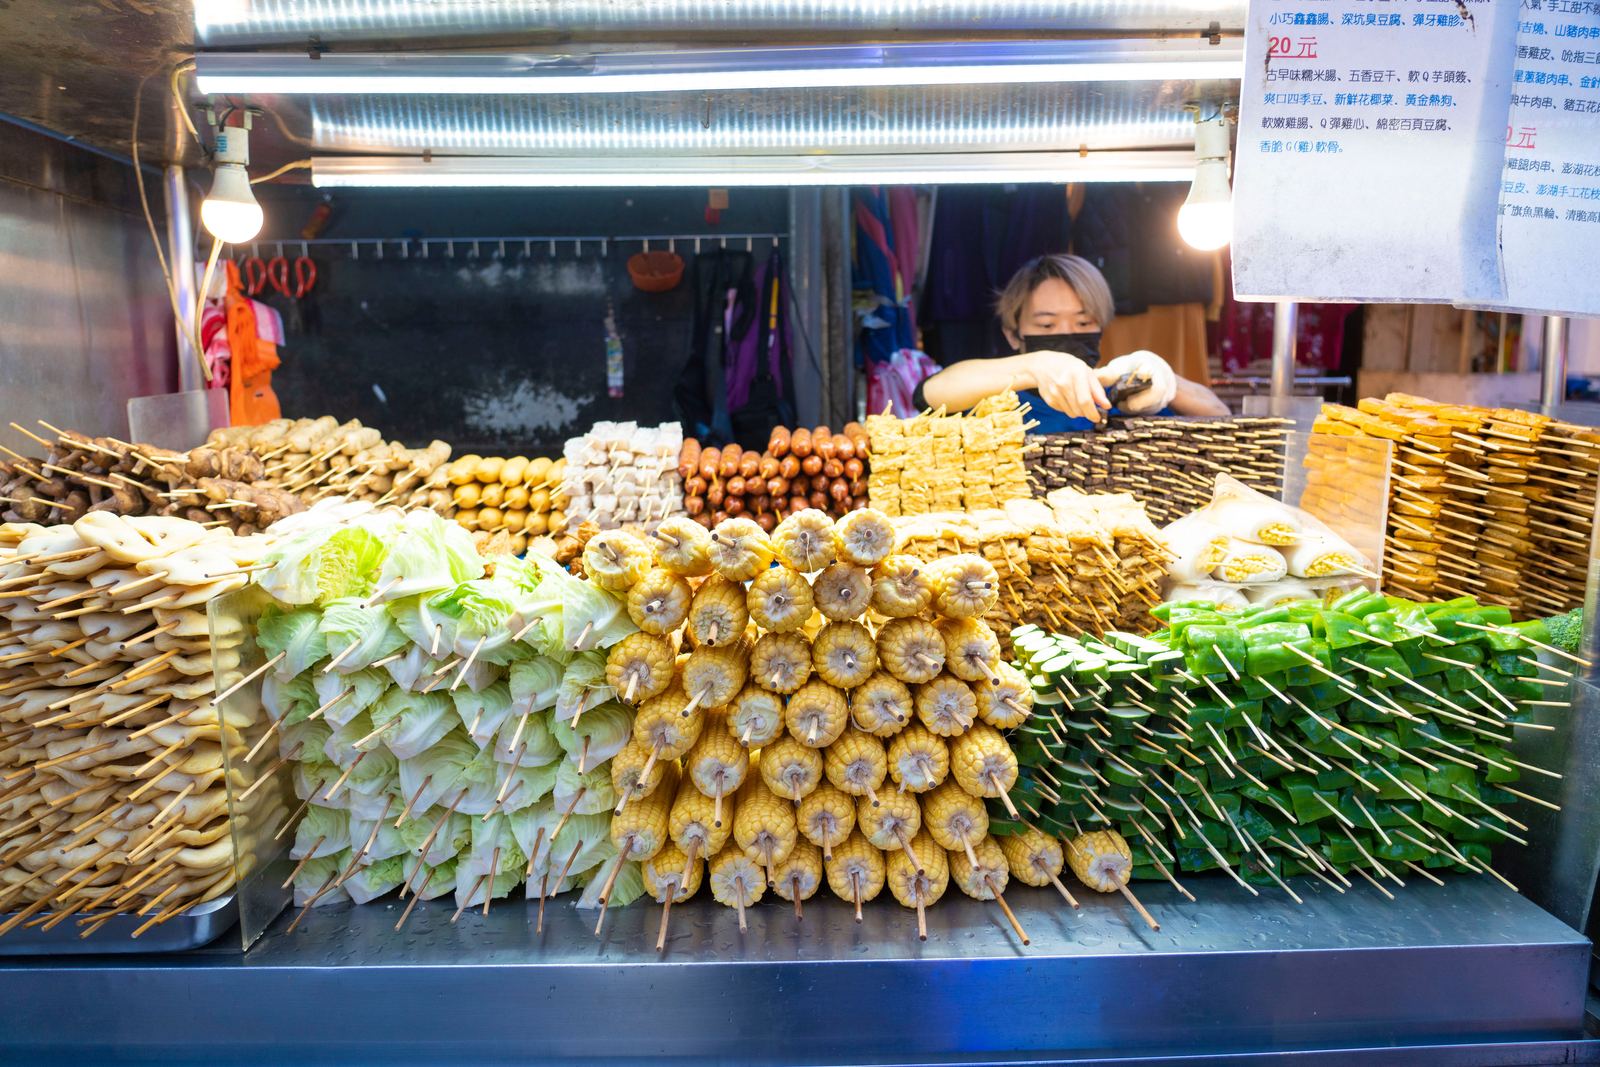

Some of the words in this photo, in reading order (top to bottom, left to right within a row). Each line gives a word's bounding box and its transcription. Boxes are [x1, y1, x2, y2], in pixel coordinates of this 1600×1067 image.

[1269, 37, 1291, 54] 20
[1297, 37, 1317, 57] 元
[1514, 45, 1600, 64] 香雞皮、吮指三
[1518, 127, 1537, 147] 元
[1504, 157, 1600, 176] 雞腿肉串、澎湖花
[1501, 181, 1600, 200] 豆皮、澎湖手工花枝
